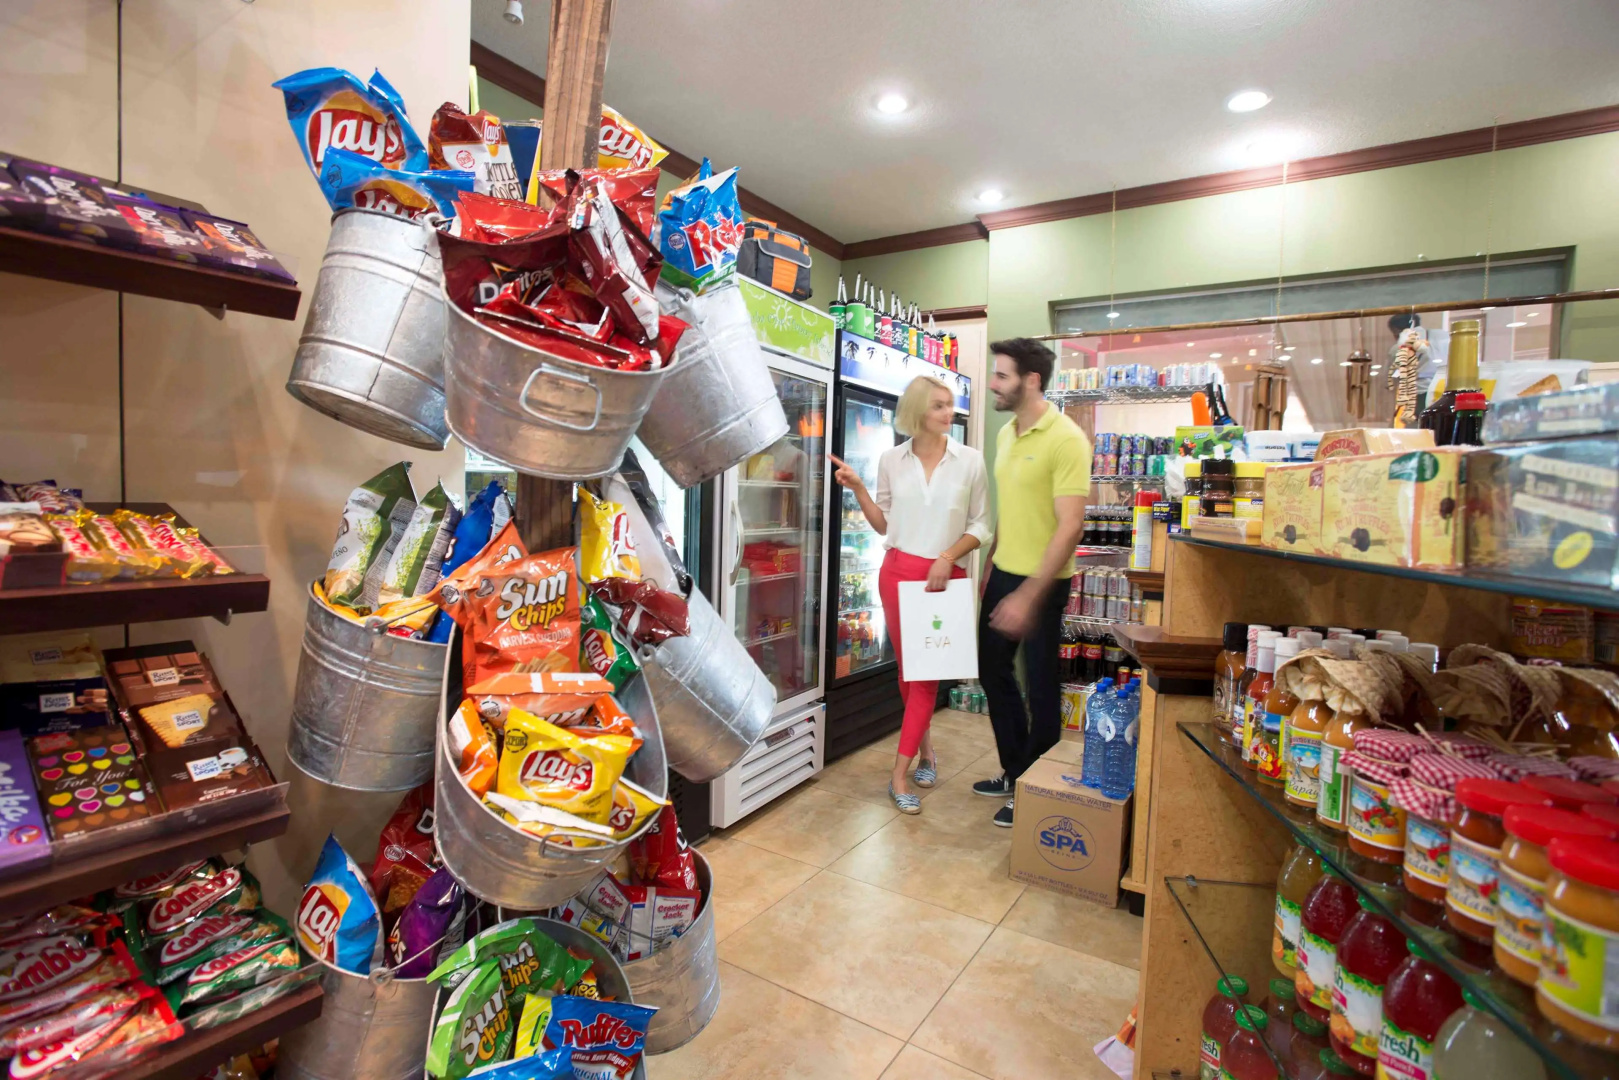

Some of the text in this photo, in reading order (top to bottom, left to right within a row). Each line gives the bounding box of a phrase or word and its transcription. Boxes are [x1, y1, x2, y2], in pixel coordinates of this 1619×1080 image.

[495, 570, 569, 620] Sun
[509, 597, 566, 631] Chips
[925, 636, 951, 649] EVA
[55, 776, 88, 790] For
[1287, 777, 1320, 800] Papay
[1024, 784, 1112, 810] NATURAL MINERAL WATER
[1040, 830, 1089, 857] SPA
[153, 870, 236, 923] Combos
[598, 887, 623, 908] Cracker
[657, 903, 690, 914] Cracker
[662, 911, 684, 920] Jack
[500, 941, 534, 972] un
[460, 981, 506, 1066] Sun
[478, 1009, 509, 1060] Chip
[557, 1013, 645, 1050] Ruffles
[1203, 1040, 1218, 1059] resh
[1380, 1023, 1420, 1064] fresh
[607, 1053, 629, 1067] Ridges
[573, 1067, 612, 1080] RIGINAL
